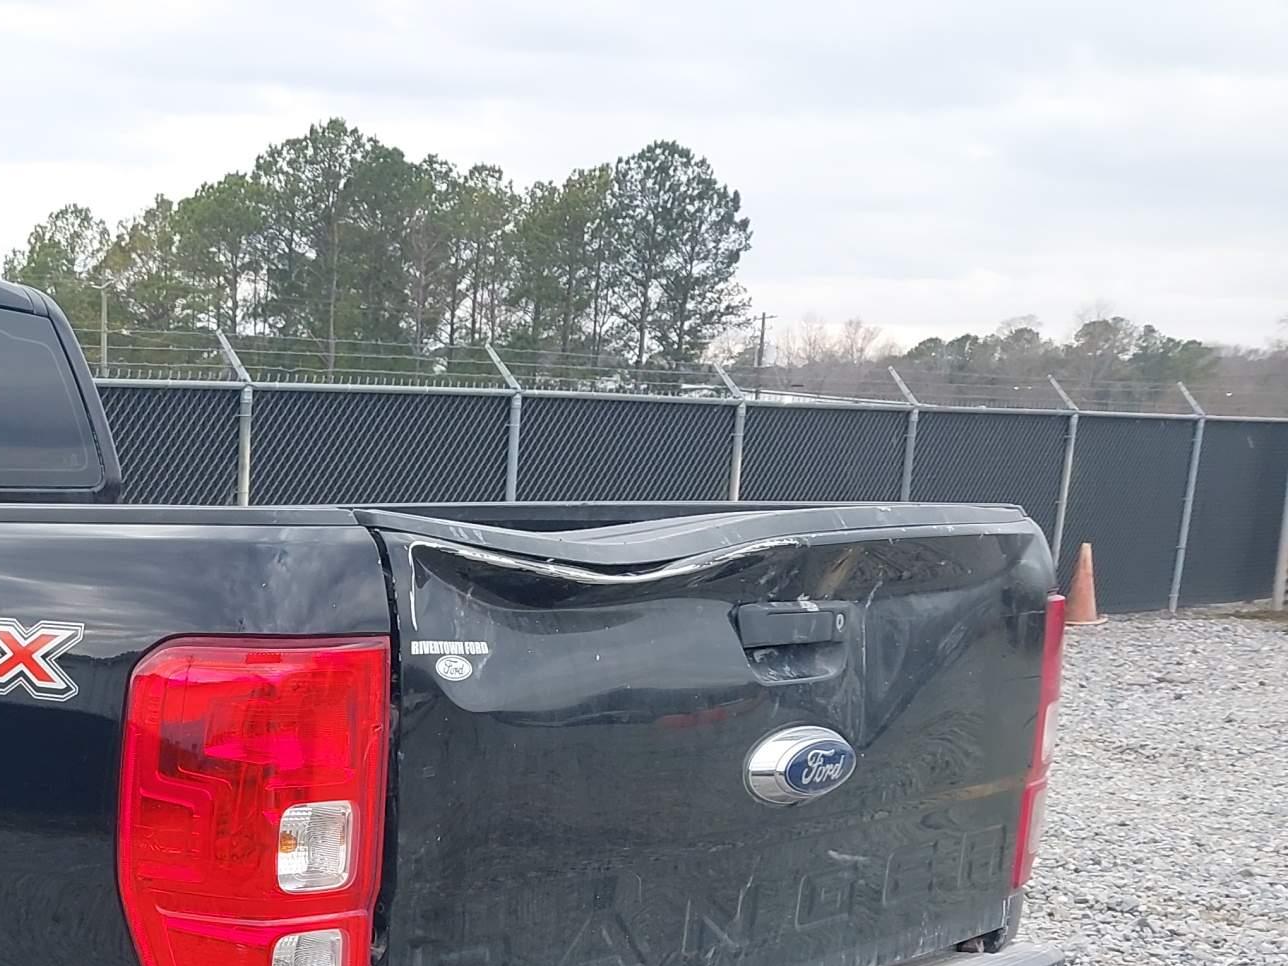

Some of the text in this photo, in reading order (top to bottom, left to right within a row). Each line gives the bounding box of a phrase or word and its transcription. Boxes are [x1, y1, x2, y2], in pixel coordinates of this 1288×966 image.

[411, 640, 489, 655] RIVERTOWN FORD
[443, 659, 465, 675] Ford
[801, 749, 845, 785] Ford
